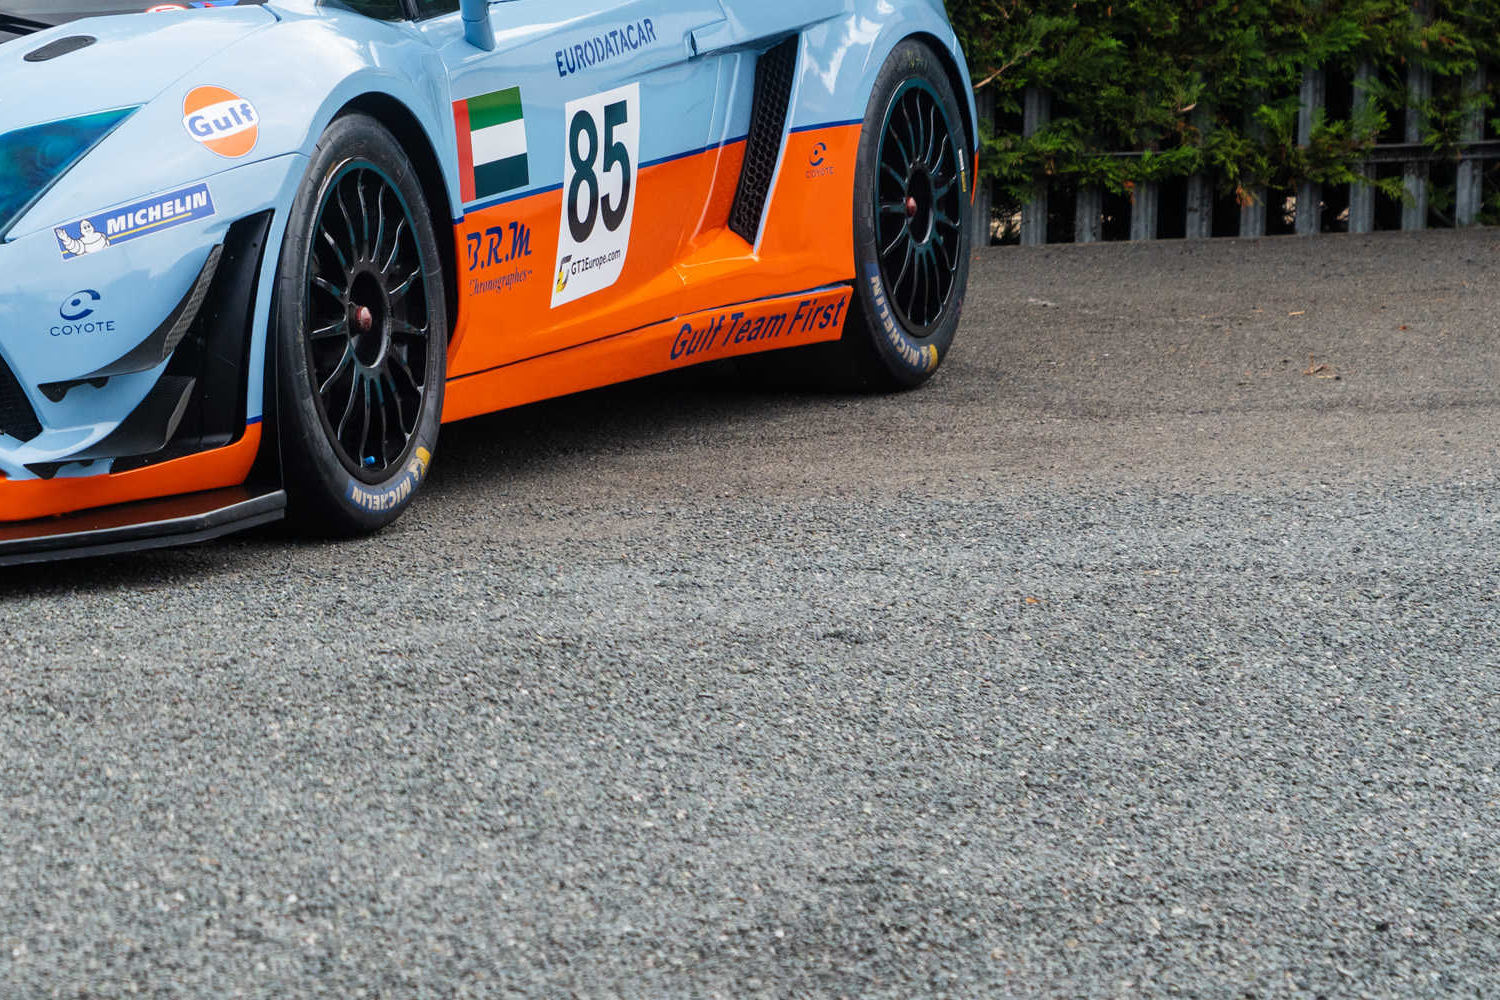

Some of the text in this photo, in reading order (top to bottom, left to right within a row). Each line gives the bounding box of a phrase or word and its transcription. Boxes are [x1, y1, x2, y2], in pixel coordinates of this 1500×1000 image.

[555, 18, 657, 78] EURODATACAR
[188, 102, 254, 138] Gulf
[567, 99, 631, 244] 85
[805, 166, 834, 179] COYOTE
[106, 190, 208, 235] MICHELIN
[571, 249, 621, 275] GT2Europe.com
[49, 320, 116, 337] COYOTE
[670, 294, 847, 360] Gulf Team First
[870, 275, 921, 367] MICHELIN
[351, 475, 412, 511] MICHELIN
